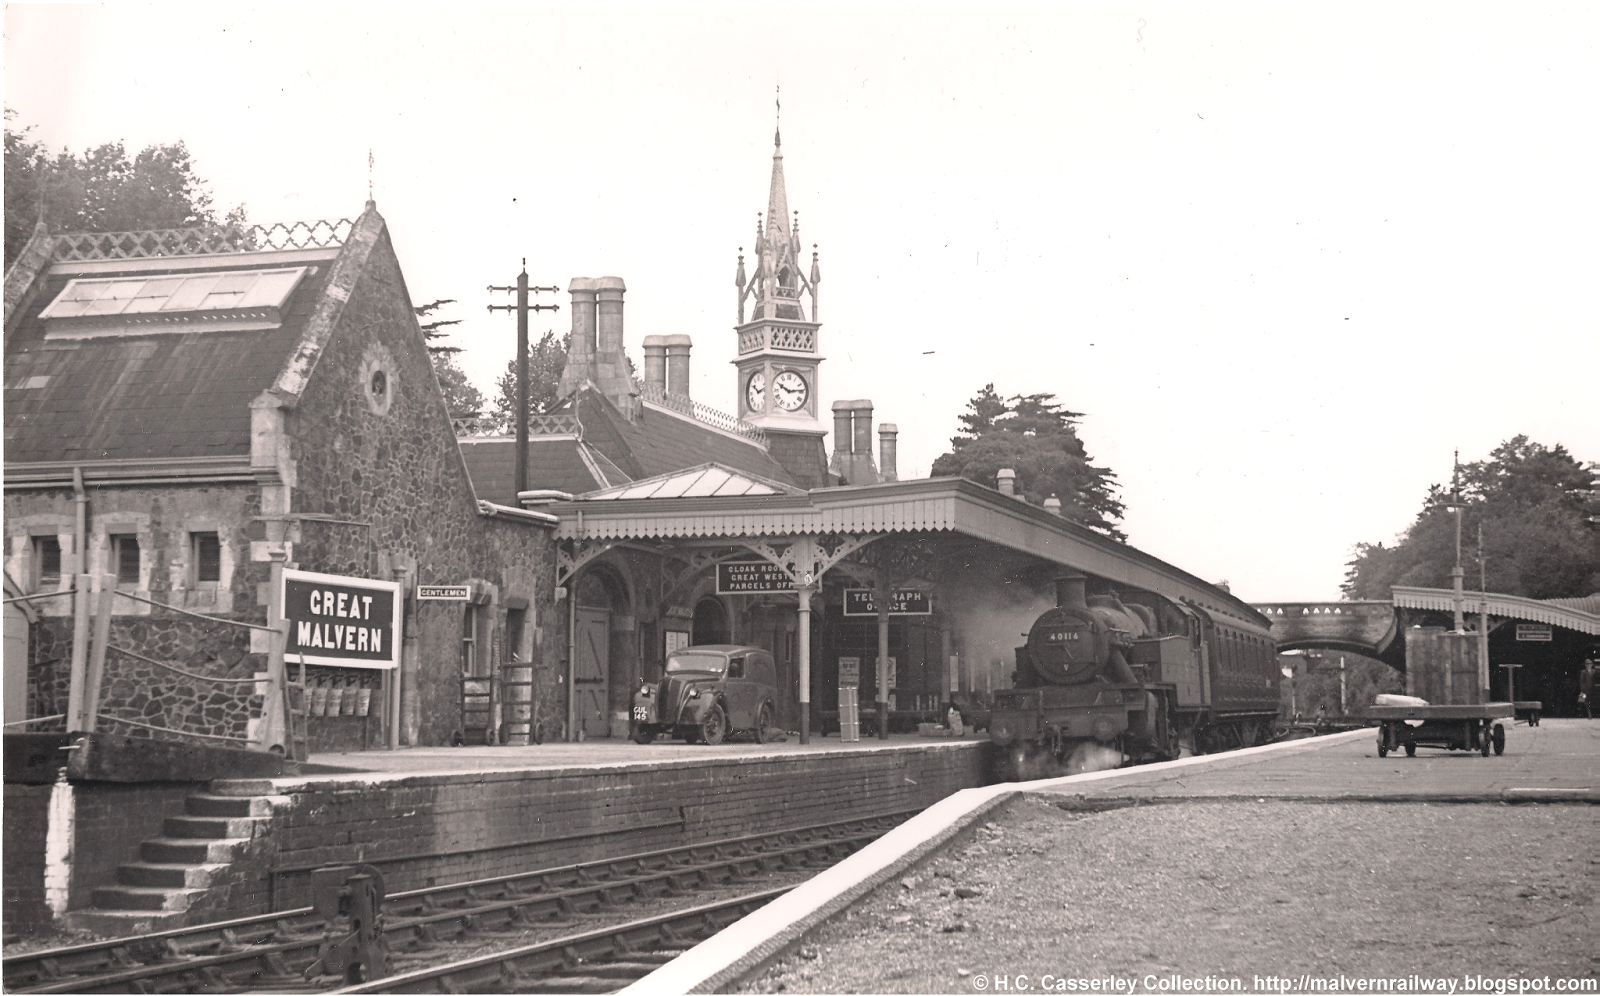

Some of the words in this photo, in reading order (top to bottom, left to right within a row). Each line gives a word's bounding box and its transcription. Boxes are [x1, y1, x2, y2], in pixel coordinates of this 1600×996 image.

[728, 565, 756, 573] CLOAK
[731, 573, 760, 581] GREAT
[729, 582, 771, 590] PARCELS
[854, 592, 921, 602] TELRAPH
[310, 589, 373, 620] GREAT
[297, 620, 382, 652] MALVERN
[1050, 632, 1078, 640] 40116
